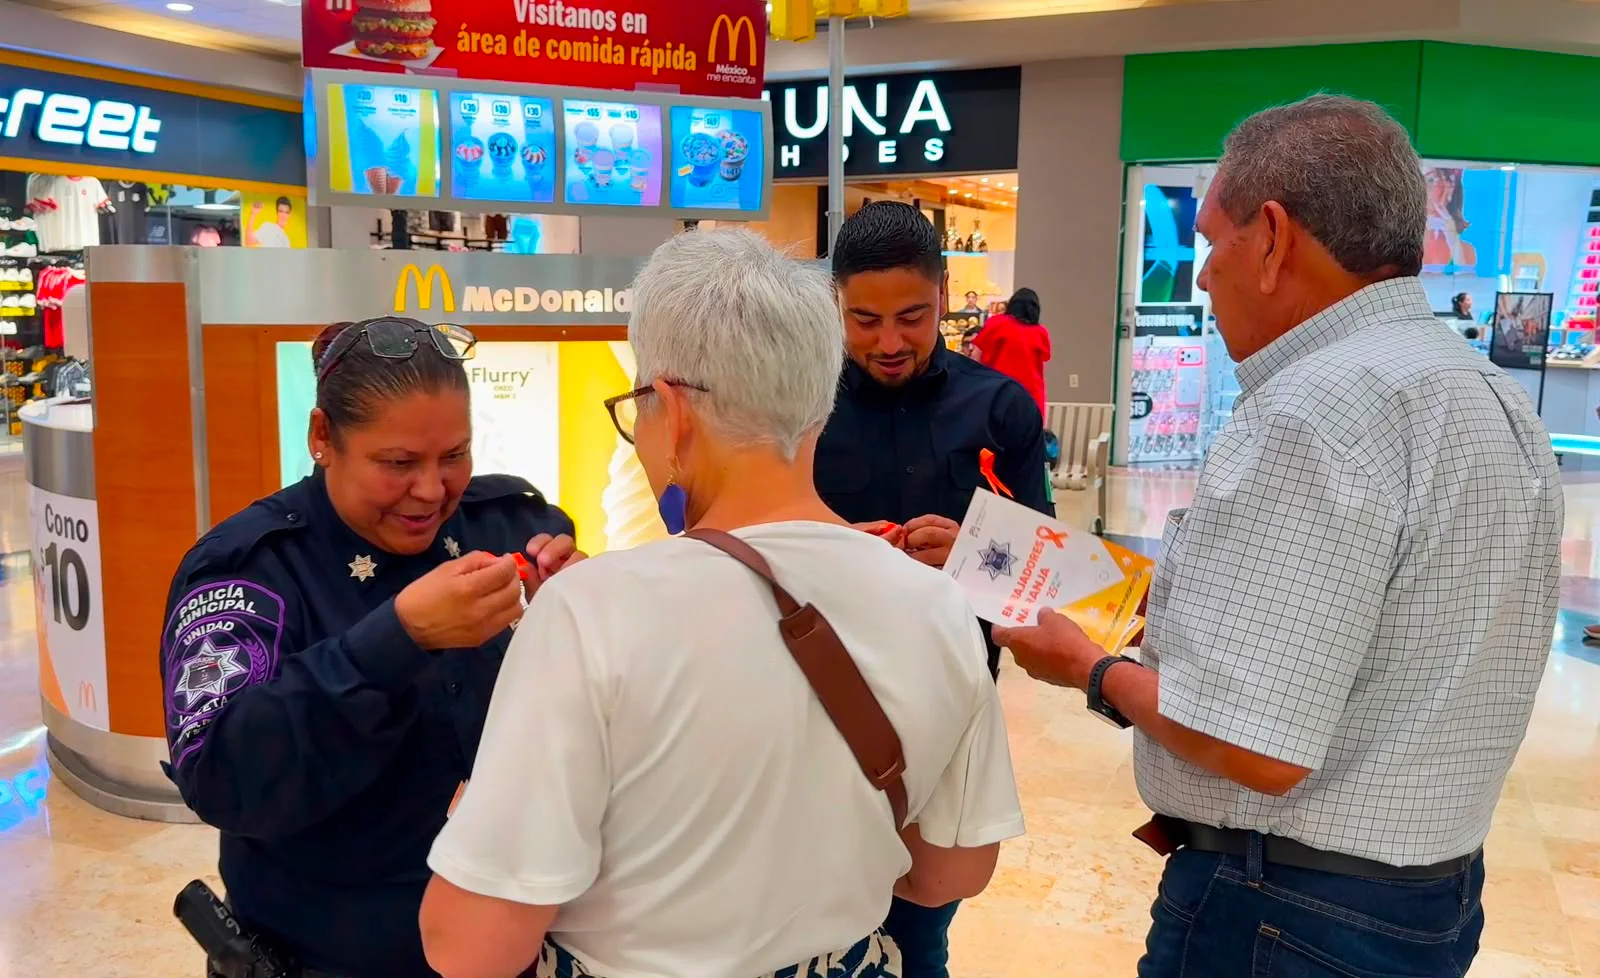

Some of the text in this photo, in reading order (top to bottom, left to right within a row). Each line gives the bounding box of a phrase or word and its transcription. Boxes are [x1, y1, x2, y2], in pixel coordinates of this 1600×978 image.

[621, 11, 648, 34] en
[457, 23, 697, 76] área de comida rápida
[706, 73, 756, 84] me encanta
[715, 63, 748, 76] México
[761, 80, 951, 139] UNA
[45, 503, 89, 543] Cono
[174, 600, 257, 638] MUNICIPAL
[179, 584, 244, 619] POLICÍA
[182, 620, 235, 646] UNIDAD
